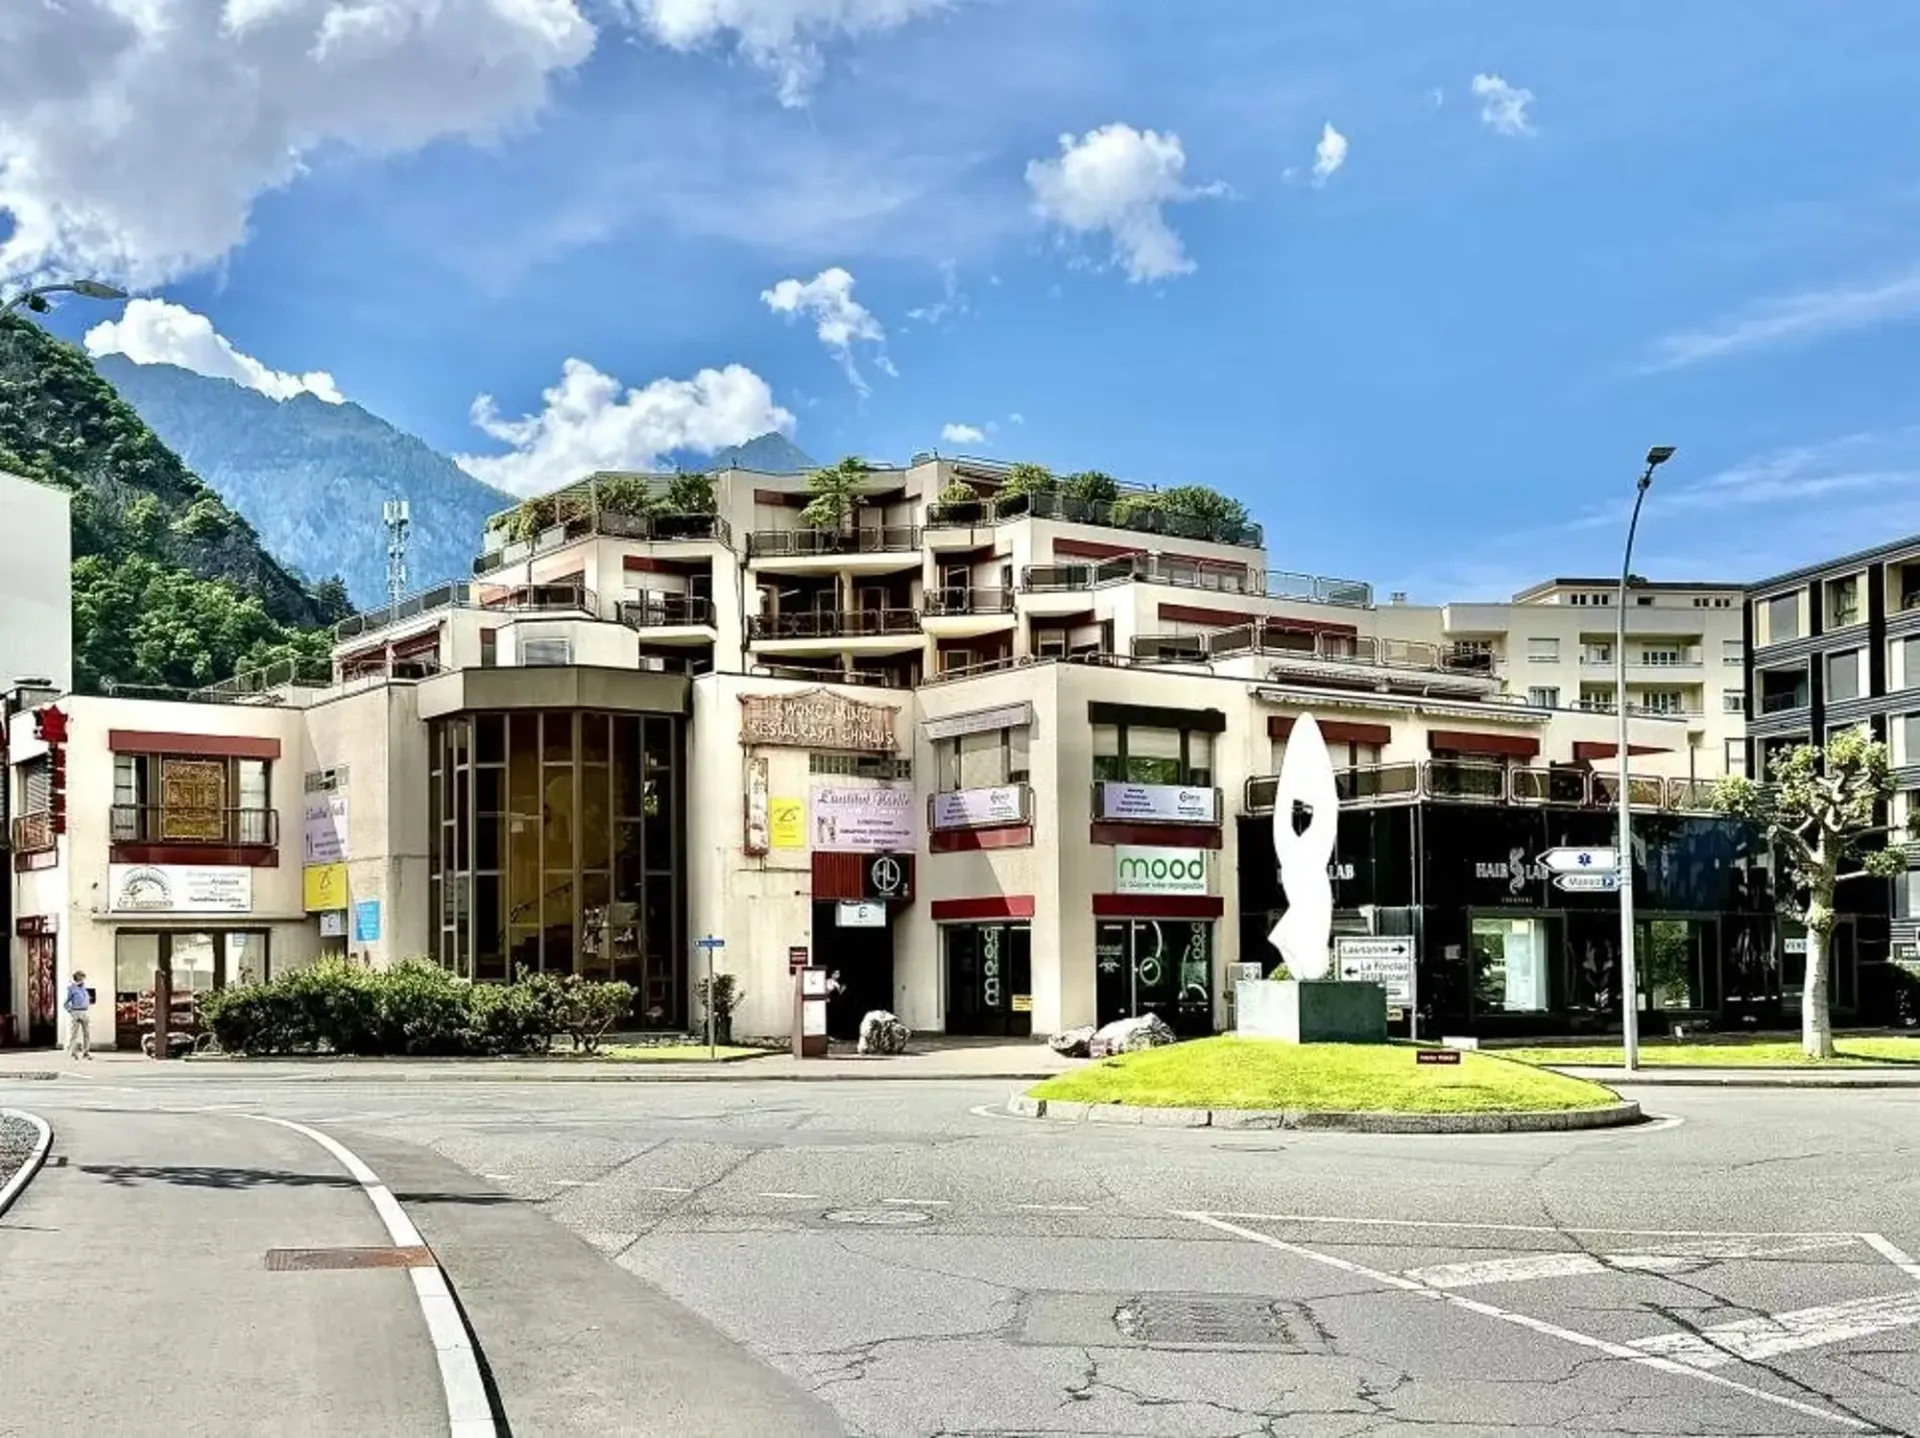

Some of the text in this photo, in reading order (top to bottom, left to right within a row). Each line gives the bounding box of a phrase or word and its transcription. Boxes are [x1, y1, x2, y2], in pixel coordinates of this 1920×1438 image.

[842, 726, 894, 746] CHINOIS
[1120, 851, 1204, 880] mood
[1327, 864, 1355, 880] LAB
[1475, 863, 1550, 880] HAIR LAB
